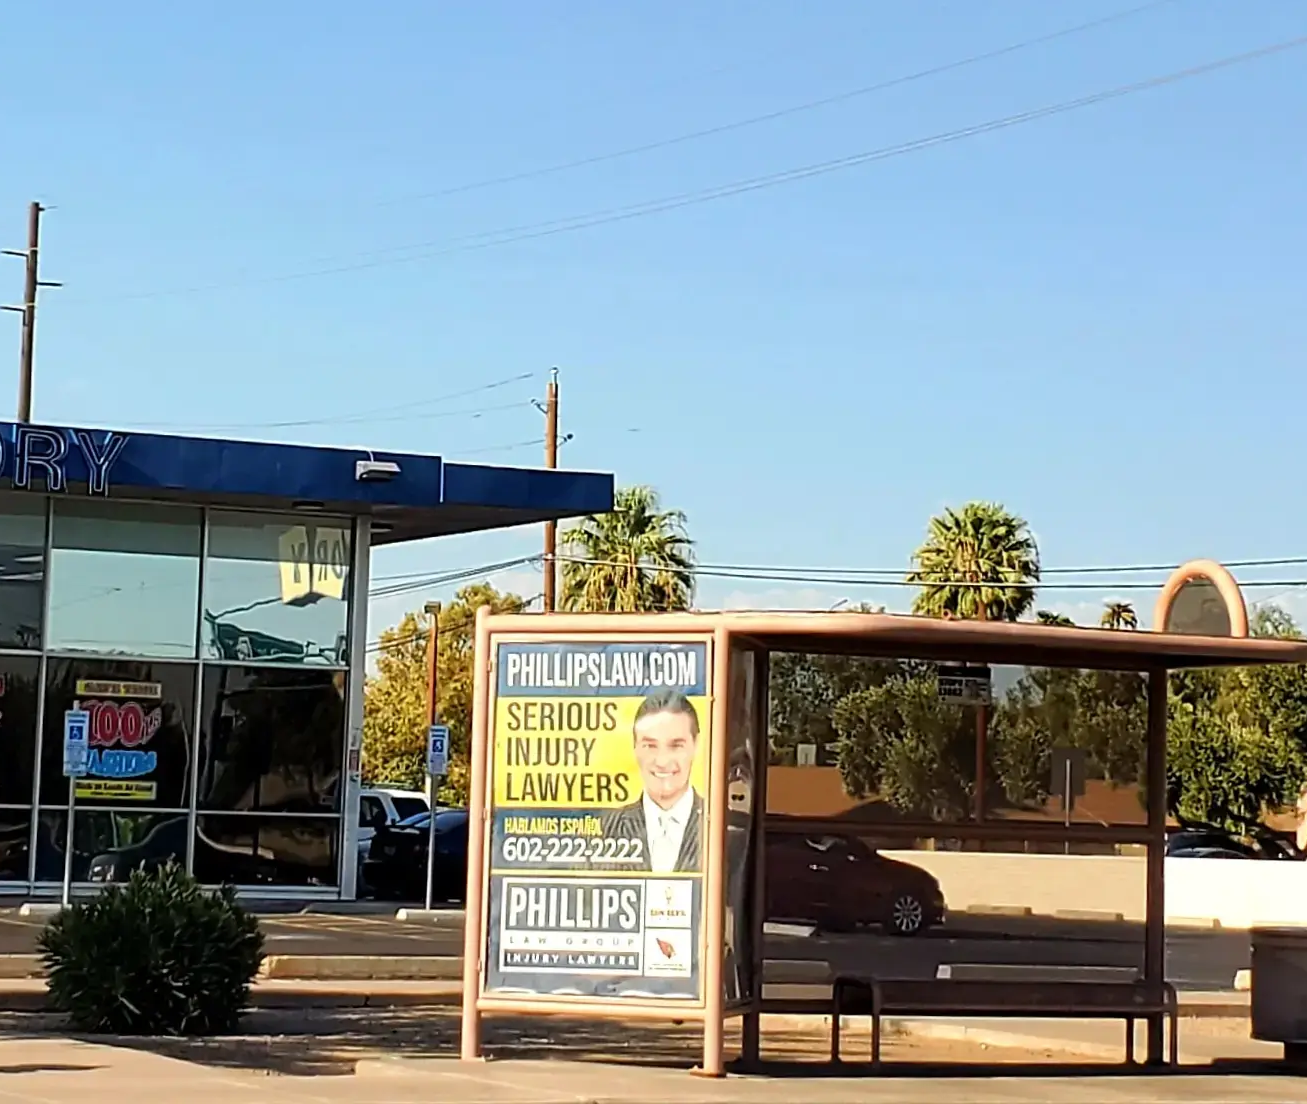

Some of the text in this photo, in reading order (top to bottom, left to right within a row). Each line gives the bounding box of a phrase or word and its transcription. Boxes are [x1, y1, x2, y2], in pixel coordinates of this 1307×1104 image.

[506, 651, 697, 688] PHILLIPSLAW.COM
[506, 701, 618, 732] SERIOUS
[506, 737, 597, 767] INJURY
[506, 772, 629, 803] LAWYERS
[504, 816, 558, 835] HABLAMOS
[502, 836, 644, 863] 602-222-2222
[509, 886, 637, 930] PHILLIPS
[509, 936, 634, 947] LAW GROUP
[506, 952, 636, 967] INJURY LAWYERS
